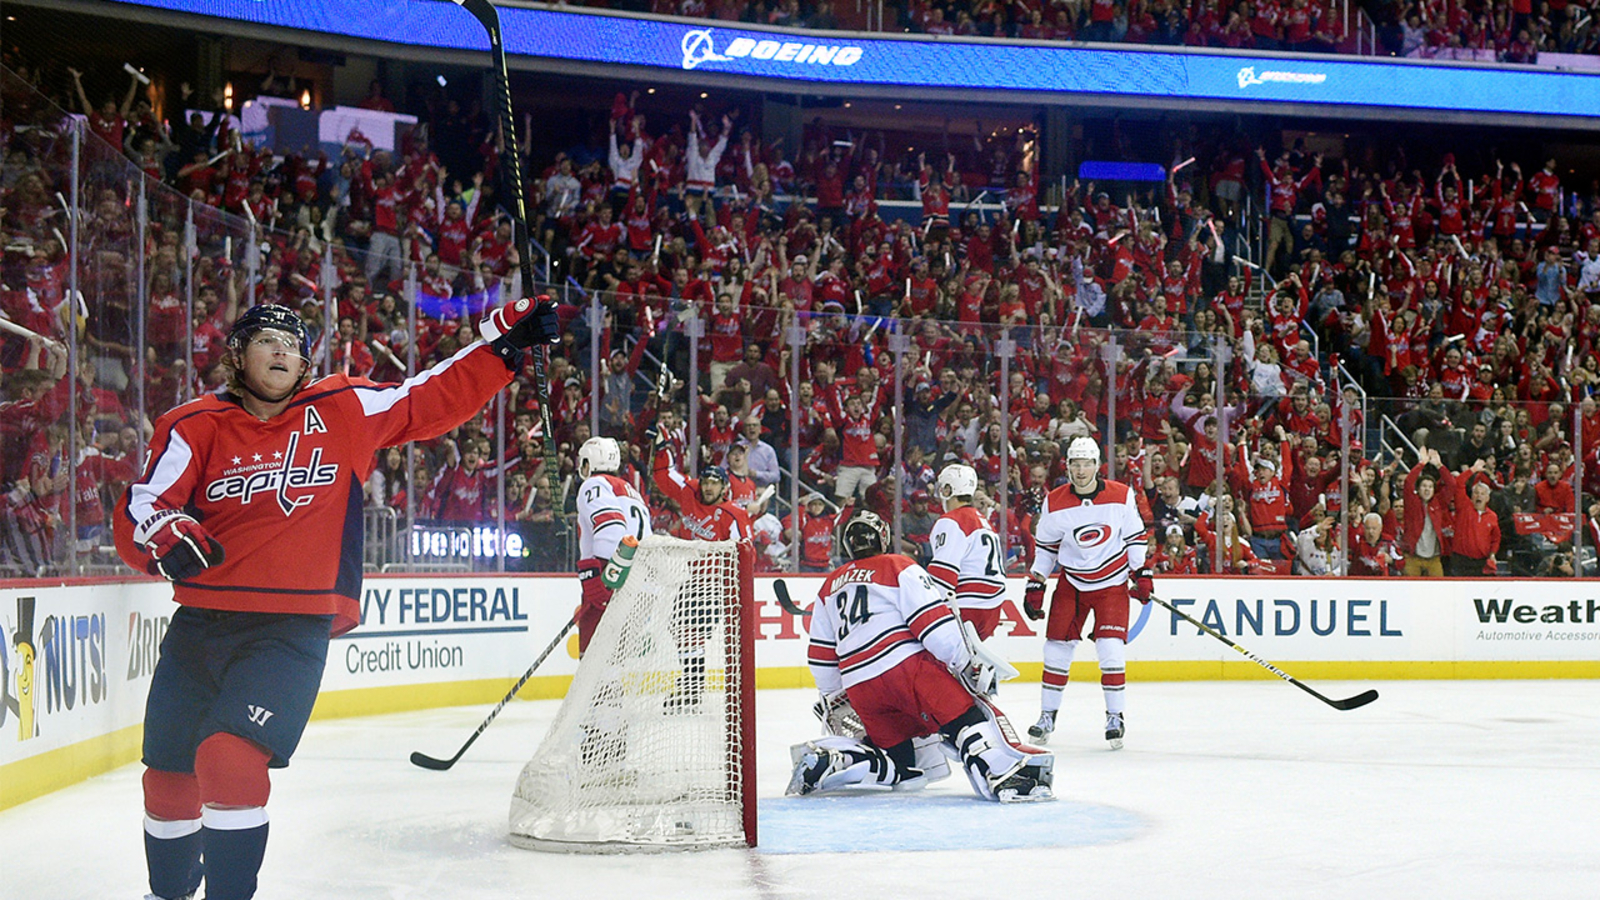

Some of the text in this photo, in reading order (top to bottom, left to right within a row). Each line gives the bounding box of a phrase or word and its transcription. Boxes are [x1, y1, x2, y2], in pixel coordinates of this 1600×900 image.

[724, 37, 864, 66] BOEING
[534, 343, 549, 399] ALPHA
[304, 405, 328, 435] A
[223, 461, 282, 476] WASHINGTON
[585, 485, 601, 503] 27
[934, 532, 947, 549] 20
[399, 587, 528, 624] FEDERAL
[835, 584, 875, 641] 34
[1170, 599, 1403, 636] FANDUEL
[1473, 598, 1600, 623] Weath
[1476, 630, 1541, 640] Automotive
[45, 612, 107, 714] NUTS!
[346, 640, 463, 674] Credit Union
